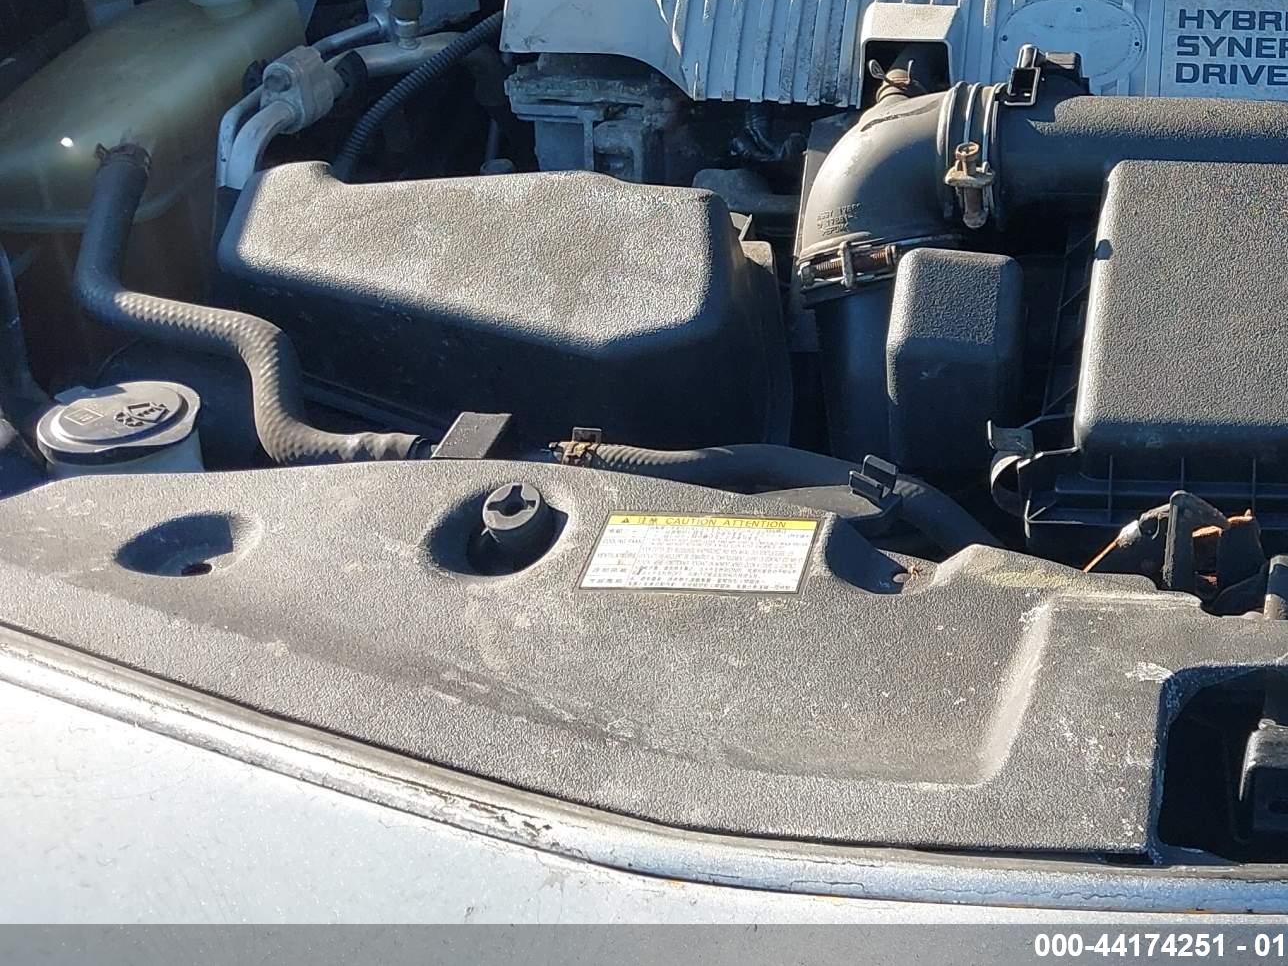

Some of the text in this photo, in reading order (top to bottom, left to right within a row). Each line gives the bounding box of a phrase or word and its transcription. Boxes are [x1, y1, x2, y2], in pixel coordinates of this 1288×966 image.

[1175, 62, 1288, 86] DRIVE
[665, 517, 716, 526] CAUTION
[722, 519, 787, 528] ATTENTION
